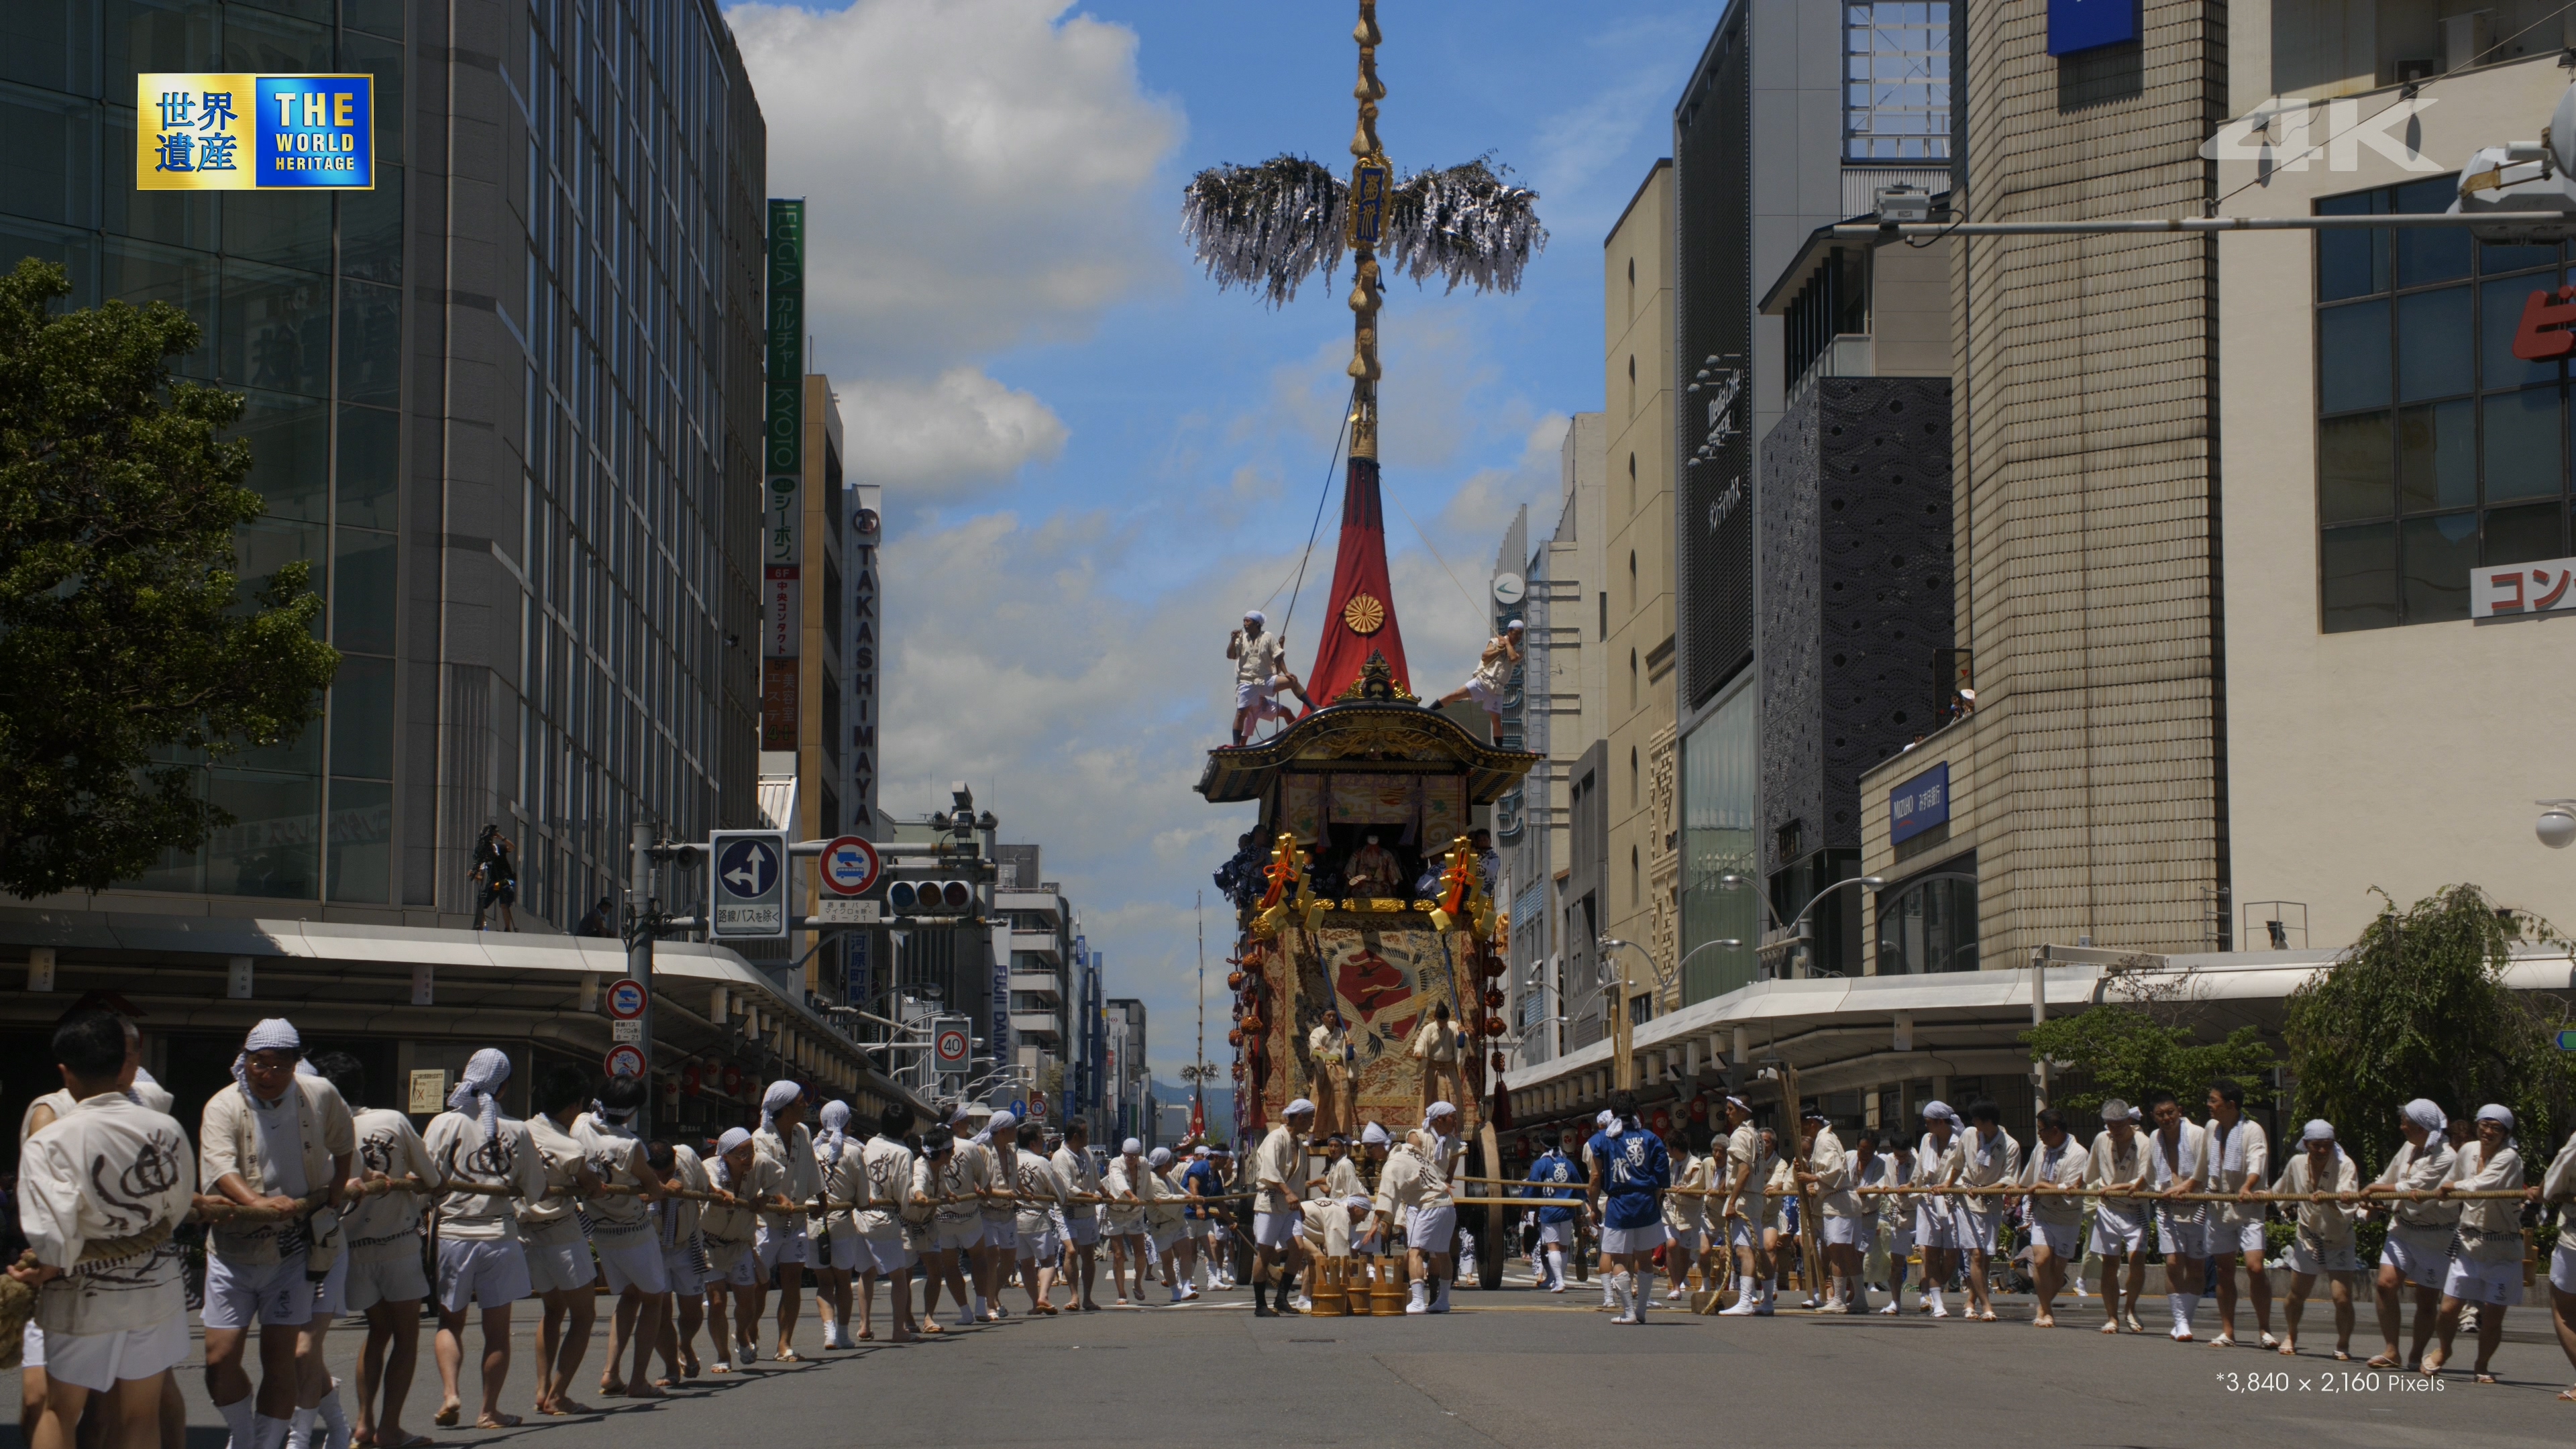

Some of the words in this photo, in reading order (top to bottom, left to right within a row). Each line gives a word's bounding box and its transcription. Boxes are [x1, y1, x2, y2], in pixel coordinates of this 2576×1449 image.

[771, 205, 798, 287] JEUGIA
[775, 294, 795, 378] カルチャー
[773, 388, 794, 468] KYOTO
[775, 568, 790, 578] 6F
[2491, 569, 2576, 610] コン
[777, 582, 788, 655] 中央コンタクト
[773, 660, 788, 671] 5F
[854, 544, 874, 826] TAKASHIMAYA
[766, 674, 781, 722] エステ
[782, 673, 795, 722] 美容室
[1893, 794, 1914, 821] MIZUHO
[1918, 784, 1940, 812] みずほ銀行
[718, 909, 779, 923] 路線バスを除く
[850, 935, 867, 1001] 河原町駅
[944, 1039, 961, 1052] 40
